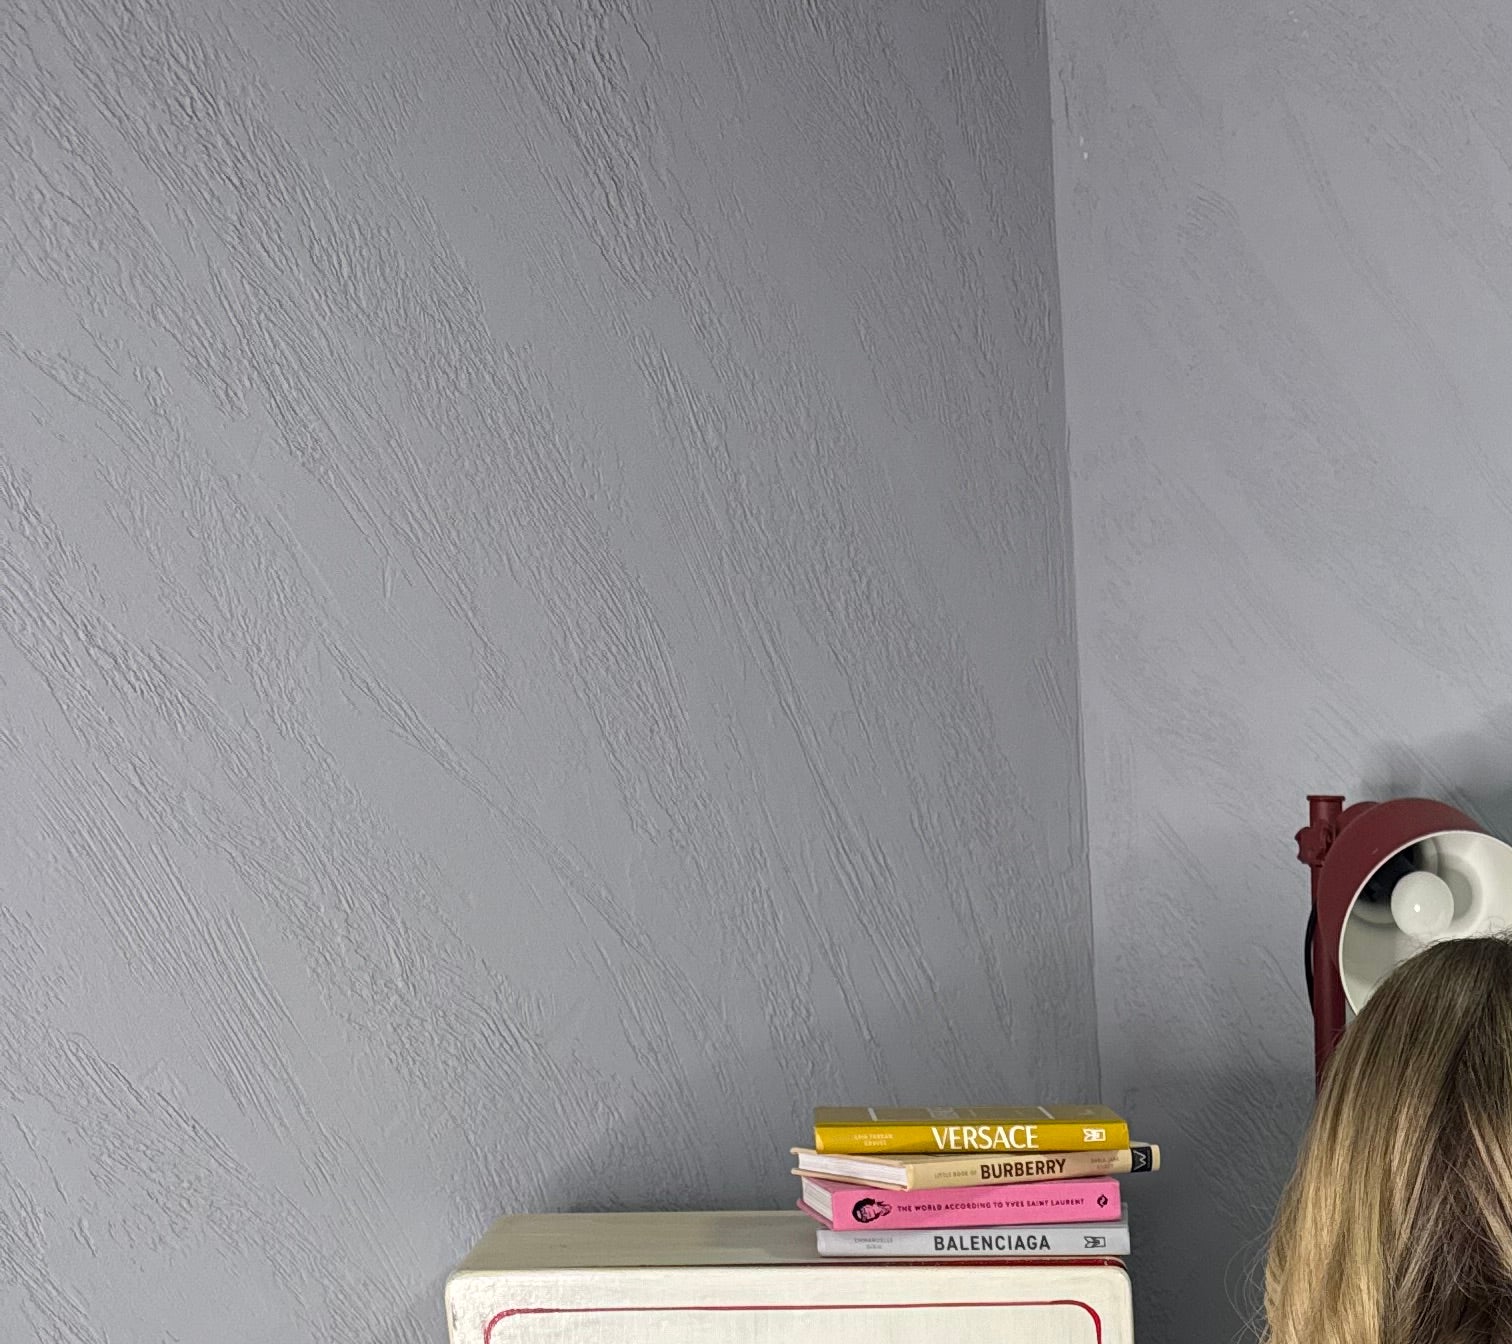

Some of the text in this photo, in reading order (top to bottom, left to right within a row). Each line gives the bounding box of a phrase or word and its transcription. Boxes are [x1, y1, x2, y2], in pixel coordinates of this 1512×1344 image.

[931, 1125, 1040, 1150] VERSACE
[980, 1158, 1066, 1180] BURBERRY
[914, 1204, 942, 1212] WORLD
[944, 1202, 991, 1211] ACCORDING
[993, 1201, 1003, 1209] TO
[1026, 1200, 1049, 1208] SAINT
[1051, 1198, 1084, 1207] LAURENT
[933, 1235, 1051, 1251] BALENCIAGA
